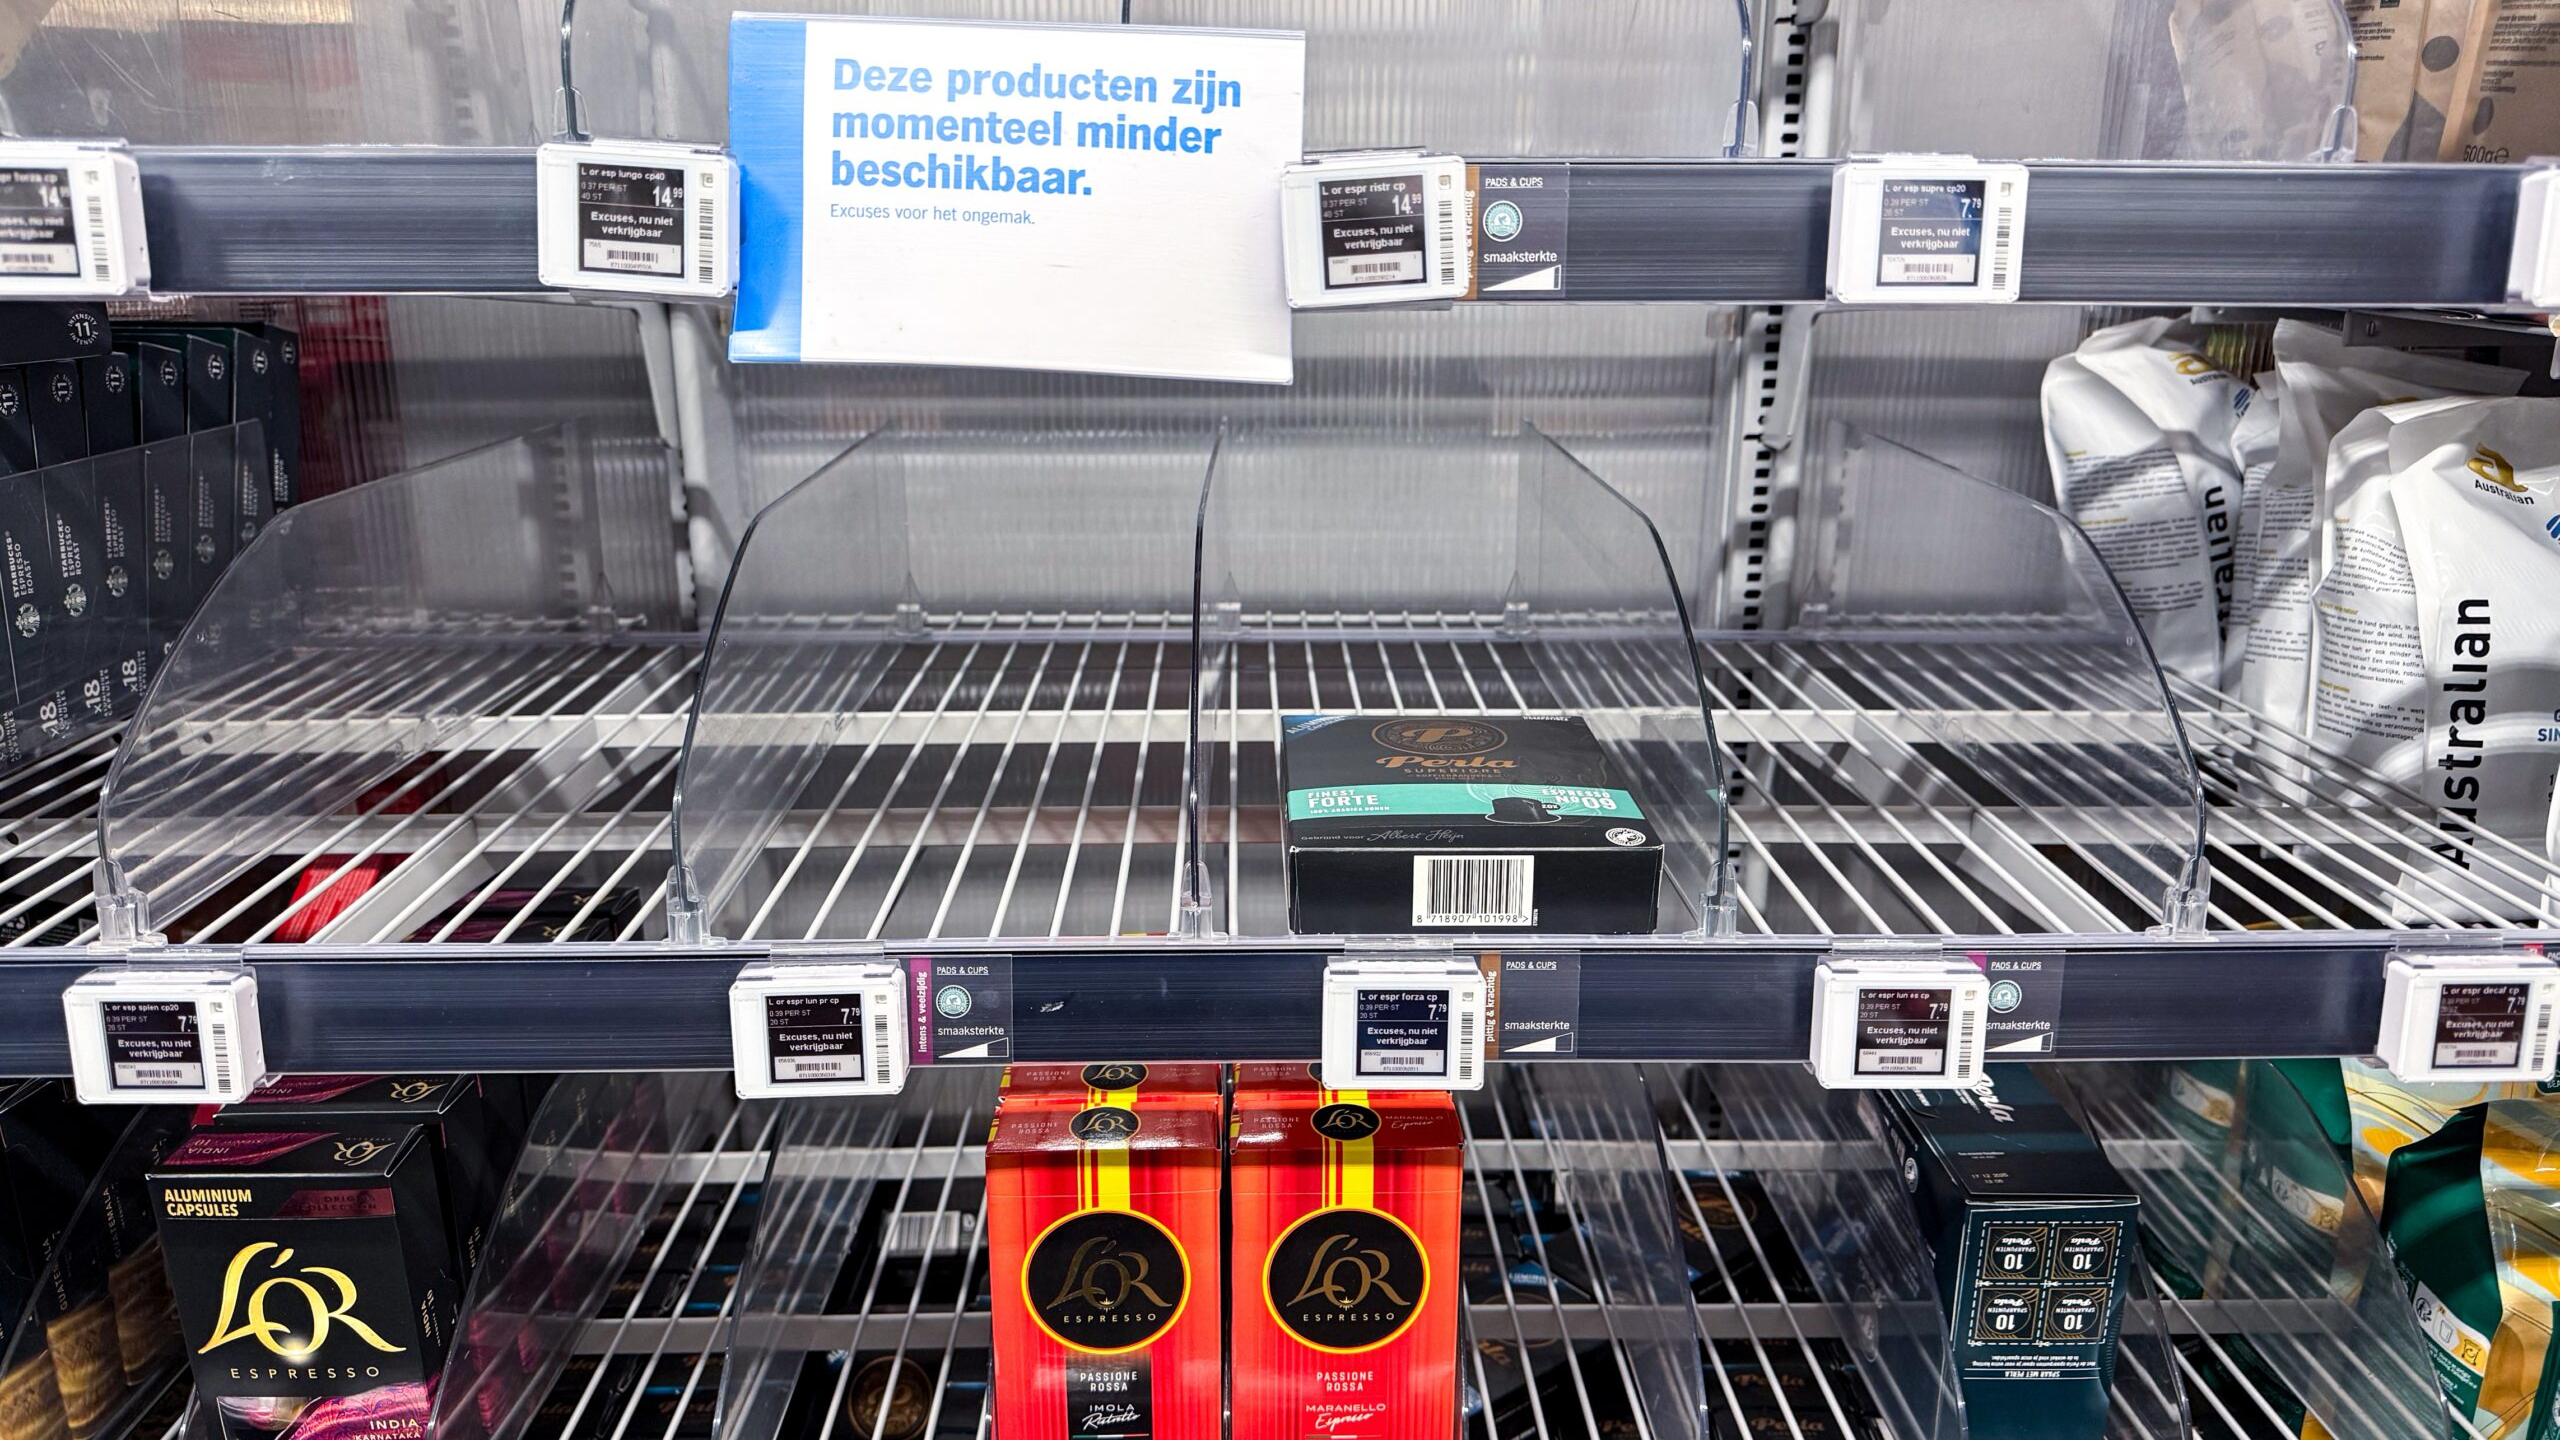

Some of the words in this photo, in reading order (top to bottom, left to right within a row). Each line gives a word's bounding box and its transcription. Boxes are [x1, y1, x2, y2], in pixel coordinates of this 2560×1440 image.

[833, 58, 933, 94] Deze
[947, 63, 1157, 102] producten
[1172, 70, 1241, 114] zijn
[832, 111, 1062, 146] momenteel
[1077, 114, 1222, 154] minder
[601, 169, 617, 178] esp
[619, 168, 643, 180] lungo
[645, 172, 665, 181] cp40
[831, 150, 1092, 196] beschikbaar.
[1322, 186, 1329, 195] L
[1331, 186, 1342, 194] or
[1344, 185, 1367, 195] espr
[1370, 183, 1391, 192] ristr
[1393, 182, 1406, 192] cp
[1485, 178, 1508, 187] PADS
[1510, 177, 1517, 187] &
[1520, 177, 1543, 187] CUPS
[1904, 185, 1919, 194] esp
[1921, 186, 1944, 194] supre
[1946, 184, 1966, 194] cp20
[590, 212, 637, 224] Excuses,
[654, 217, 673, 226] niet
[830, 203, 890, 219] Excuses
[894, 207, 927, 220] voor
[933, 206, 957, 221] het
[962, 208, 1035, 226] ongemak.
[601, 225, 663, 238] verkrijgbaar
[1333, 227, 1378, 238] Excuses,
[1380, 226, 1393, 234] nu
[1395, 224, 1414, 234] niet
[1891, 227, 1935, 238] Excuses,
[1952, 227, 1970, 237] niet
[1344, 238, 1404, 250] verkrijgbaar
[1901, 239, 1959, 250] verkrijgbaar
[1483, 251, 1558, 263] smaaksterkte
[75, 321, 90, 337] 11
[2474, 478, 2535, 505] Australian
[14, 543, 27, 596] ESPRESSO
[23, 560, 34, 594] ROAST
[84, 679, 102, 714] x18
[39, 701, 60, 738] x18
[2430, 599, 2491, 871] Australian
[1376, 756, 1518, 768] Perla
[1308, 789, 1355, 799] FINEST
[1541, 788, 1611, 798] ESPRESSO
[1308, 794, 1379, 808] FORTE
[1582, 796, 1617, 810] 09
[1367, 830, 1426, 842] Albert
[1425, 829, 1465, 842] Heijn
[1416, 915, 1423, 923] 8
[1431, 915, 1471, 923] 718907
[936, 966, 957, 975] PADS
[959, 966, 966, 974] &
[967, 966, 989, 974] CUPS
[1506, 961, 1526, 970] PADS
[1528, 961, 1534, 969] &
[1536, 961, 1557, 969] CUPS
[1991, 961, 2011, 970] PADS
[2013, 961, 2019, 969] &
[2021, 961, 2042, 969] CUPS
[917, 971, 928, 1014] veelzijdig
[1486, 970, 1497, 1008] krachtig
[2442, 986, 2448, 995] L
[2462, 987, 2481, 996] espr
[2483, 986, 2507, 995] decaf
[2509, 987, 2519, 996] cp
[1380, 994, 1400, 1002] espr
[1427, 994, 1438, 1002] cp
[161, 1004, 180, 1012] cp20
[918, 1015, 927, 1023] &
[1505, 1020, 1570, 1030] smaaksterkte
[1986, 1020, 2050, 1031] smaaksterkte
[779, 1033, 820, 1042] Excuses,
[836, 1032, 853, 1040] niet
[937, 1025, 1004, 1036] smaaksterkte
[1367, 1027, 1407, 1036] Excuses,
[1422, 1027, 1438, 1035] niet
[1867, 1026, 1907, 1035] Excuses,
[1921, 1026, 1938, 1034] niet
[118, 1040, 159, 1048] Excuses,
[175, 1040, 192, 1048] niet
[918, 1026, 927, 1053] intens
[1376, 1037, 1429, 1046] verkrijgbaar
[1876, 1036, 1928, 1046] verkrijgbaar
[789, 1043, 844, 1052] verkrijgbaar
[129, 1050, 183, 1059] verkrijgbaar
[164, 1188, 252, 1204] ALUMINIUM
[167, 1202, 239, 1217] CAPSULES
[2004, 1254, 2025, 1270] 10
[2072, 1254, 2093, 1270] 10
[1046, 1236, 1173, 1310] L'OR
[1286, 1233, 1411, 1309] L'OR
[198, 1241, 406, 1357] L'OR
[1063, 1312, 1158, 1324] ESPRESSO
[1303, 1311, 1396, 1323] ESPRESSO
[1995, 1314, 2017, 1330] 10
[2064, 1314, 2084, 1330] 10
[230, 1366, 380, 1379] ESPRESSO
[1080, 1371, 1138, 1384] PASSIONE
[1316, 1370, 1374, 1383] PASSIONE
[1090, 1380, 1129, 1392] ROSSA
[1326, 1380, 1364, 1392] ROSSA
[1089, 1403, 1135, 1414] IMOLA
[1305, 1403, 1386, 1413] MARANELLO
[369, 1418, 419, 1430] INDIA
[1081, 1411, 1142, 1430] Ristretto
[1315, 1411, 1374, 1431] Espresso
